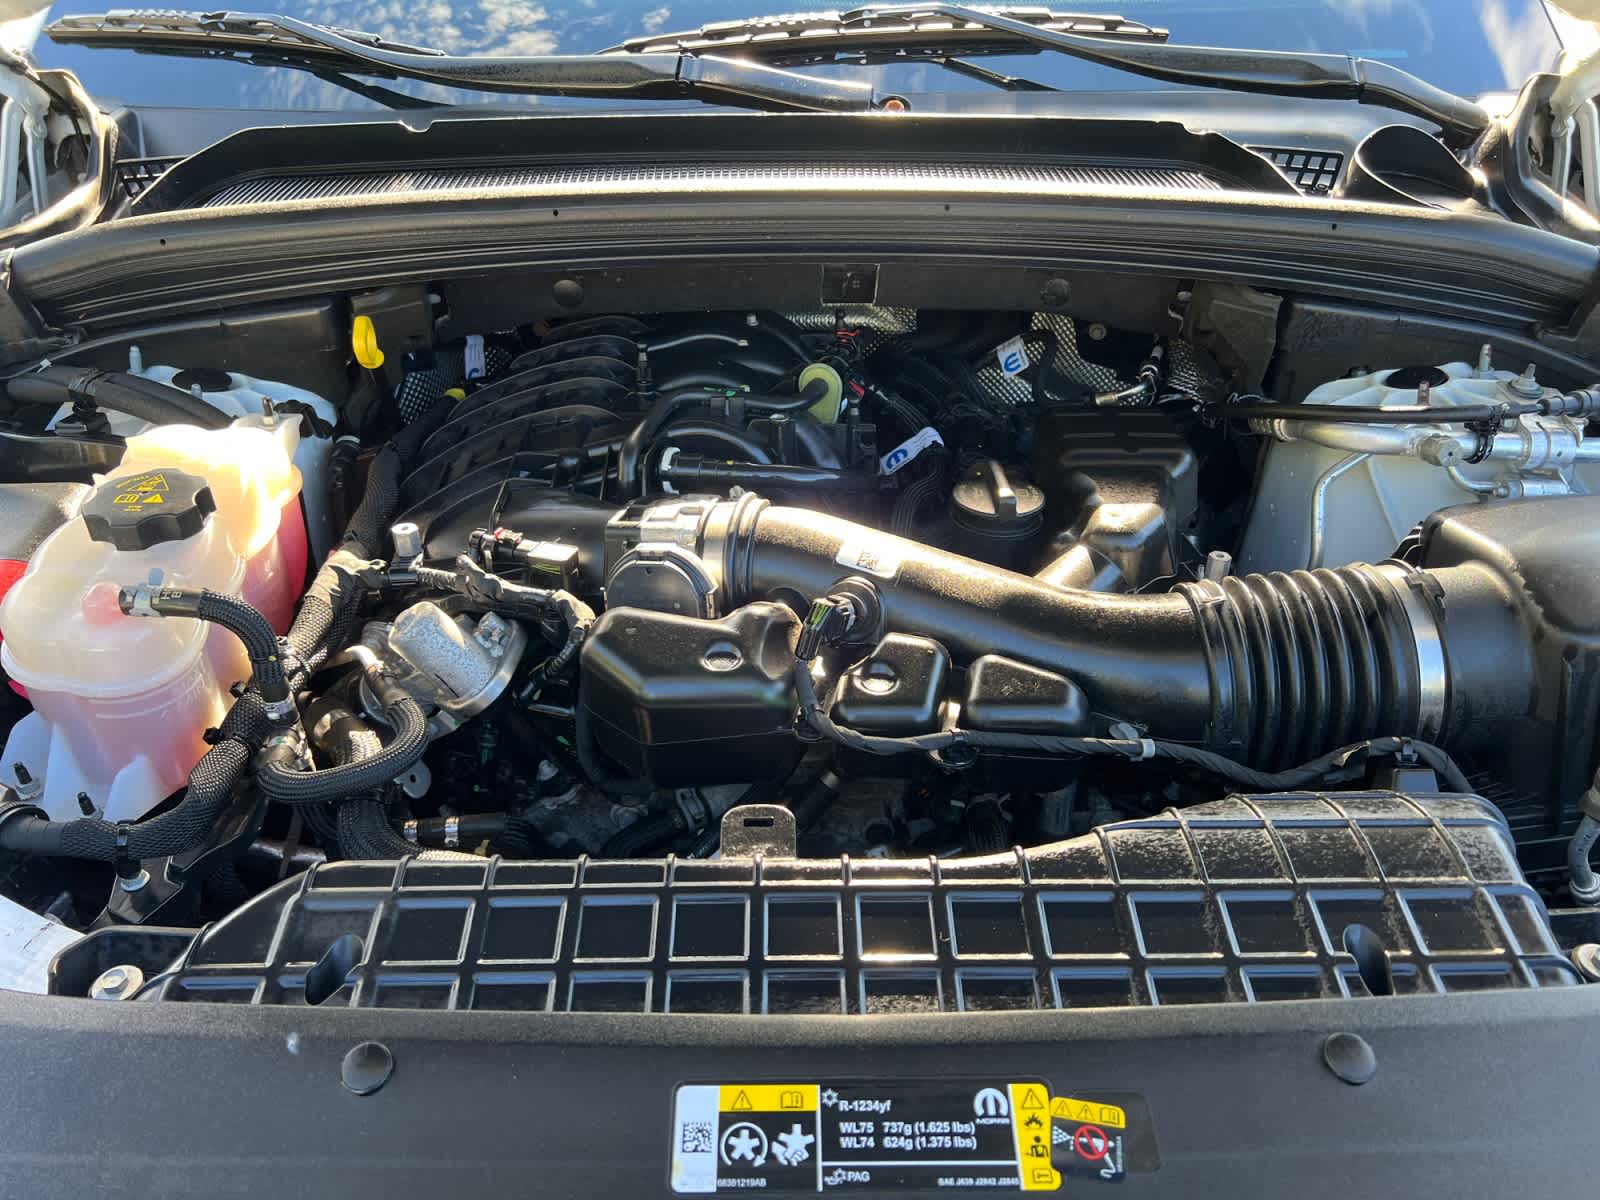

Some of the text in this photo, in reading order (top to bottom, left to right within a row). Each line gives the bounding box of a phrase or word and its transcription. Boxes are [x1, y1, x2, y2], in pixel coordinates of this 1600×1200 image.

[839, 1100, 891, 1114] R-1234yf
[839, 1120, 976, 1136] WL75 737g (1.625 lbs)
[840, 1136, 977, 1151] WL74 624g (1.375 lbs)
[847, 1171, 871, 1183] PAG
